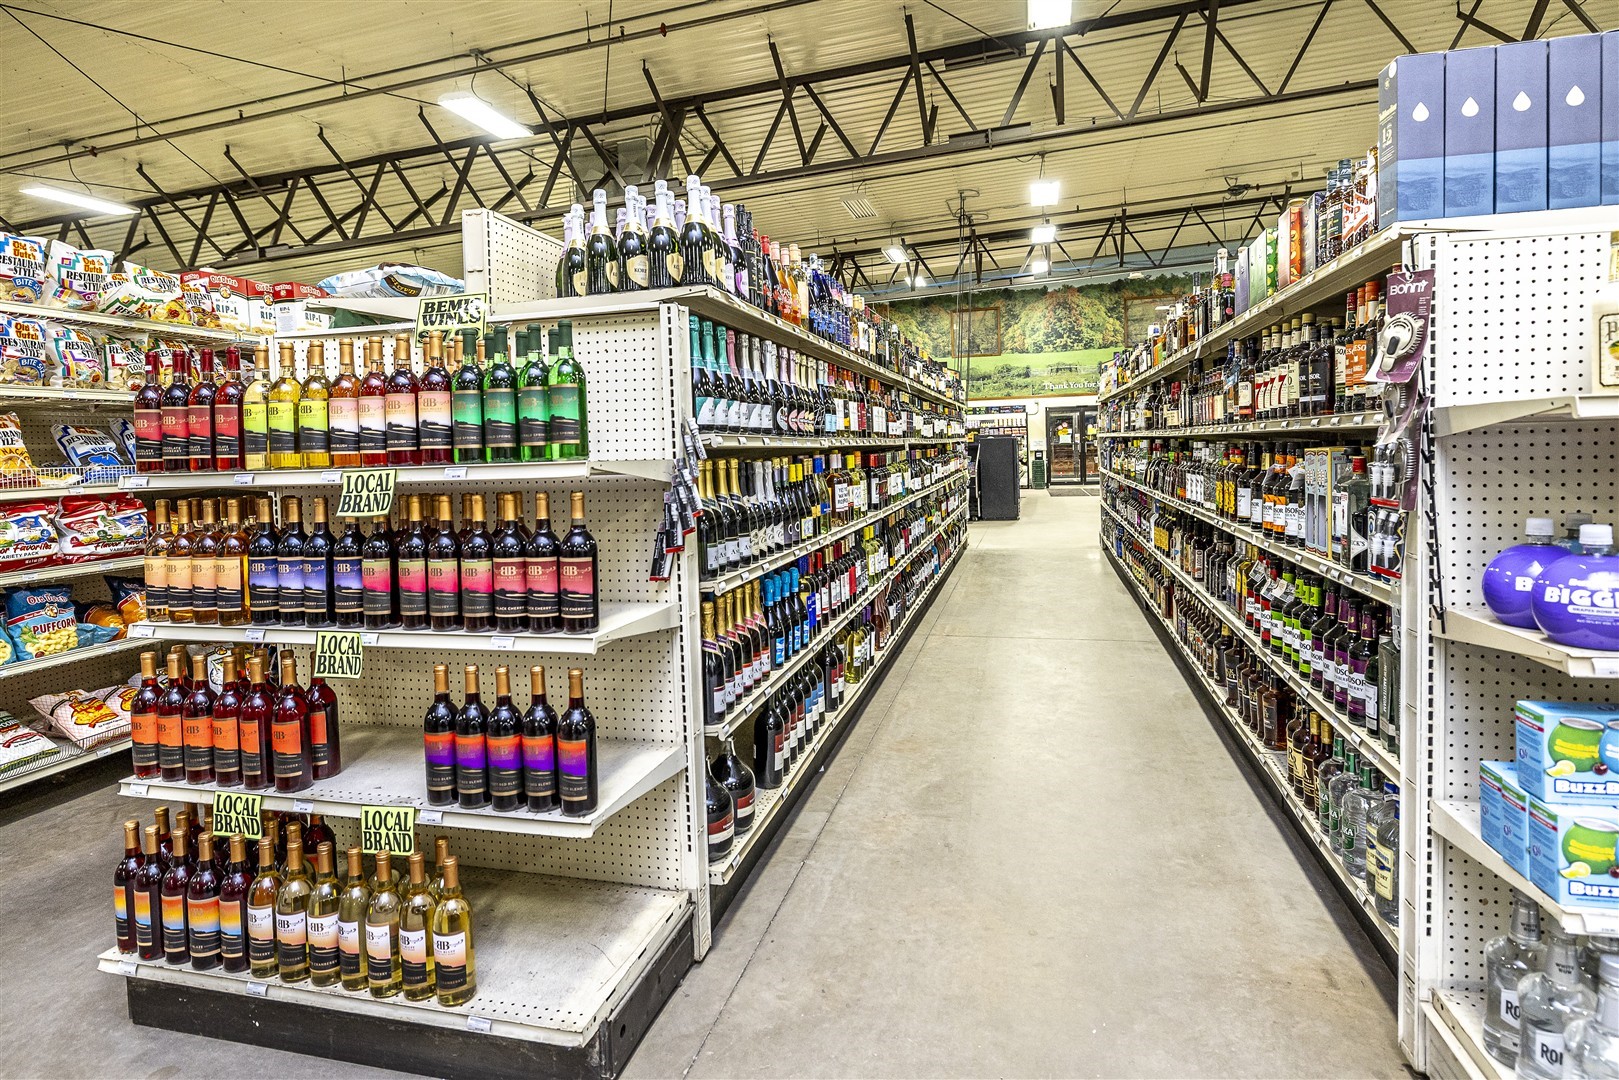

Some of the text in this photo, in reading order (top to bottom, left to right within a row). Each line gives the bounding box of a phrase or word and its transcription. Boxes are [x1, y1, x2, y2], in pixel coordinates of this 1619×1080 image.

[0, 255, 44, 271] ESTAURAN
[13, 266, 37, 279] STYLE
[16, 279, 33, 287] BITE
[83, 282, 99, 291] STYL
[216, 304, 238, 315] RIP-L
[260, 311, 276, 319] RIP-
[305, 312, 322, 323] RIP-L
[15, 322, 31, 331] Old
[1, 337, 46, 350] RESTAURAN
[15, 331, 39, 341] Dutch
[1045, 382, 1068, 390] Thank
[346, 473, 392, 494] LOCAL
[339, 492, 391, 513] BRAND
[13, 543, 52, 554] Favorites
[32, 617, 77, 635] PUFFCORN
[320, 635, 361, 655] LOCAL
[316, 655, 361, 675] BRAND
[1554, 779, 1619, 796] BuzzB
[216, 794, 258, 817] LOCAL
[214, 813, 260, 836] BRAND
[364, 810, 411, 832] LOCAL
[363, 831, 412, 852] BRAND
[1568, 880, 1619, 898] Buzz
[1506, 1000, 1521, 1020] RO
